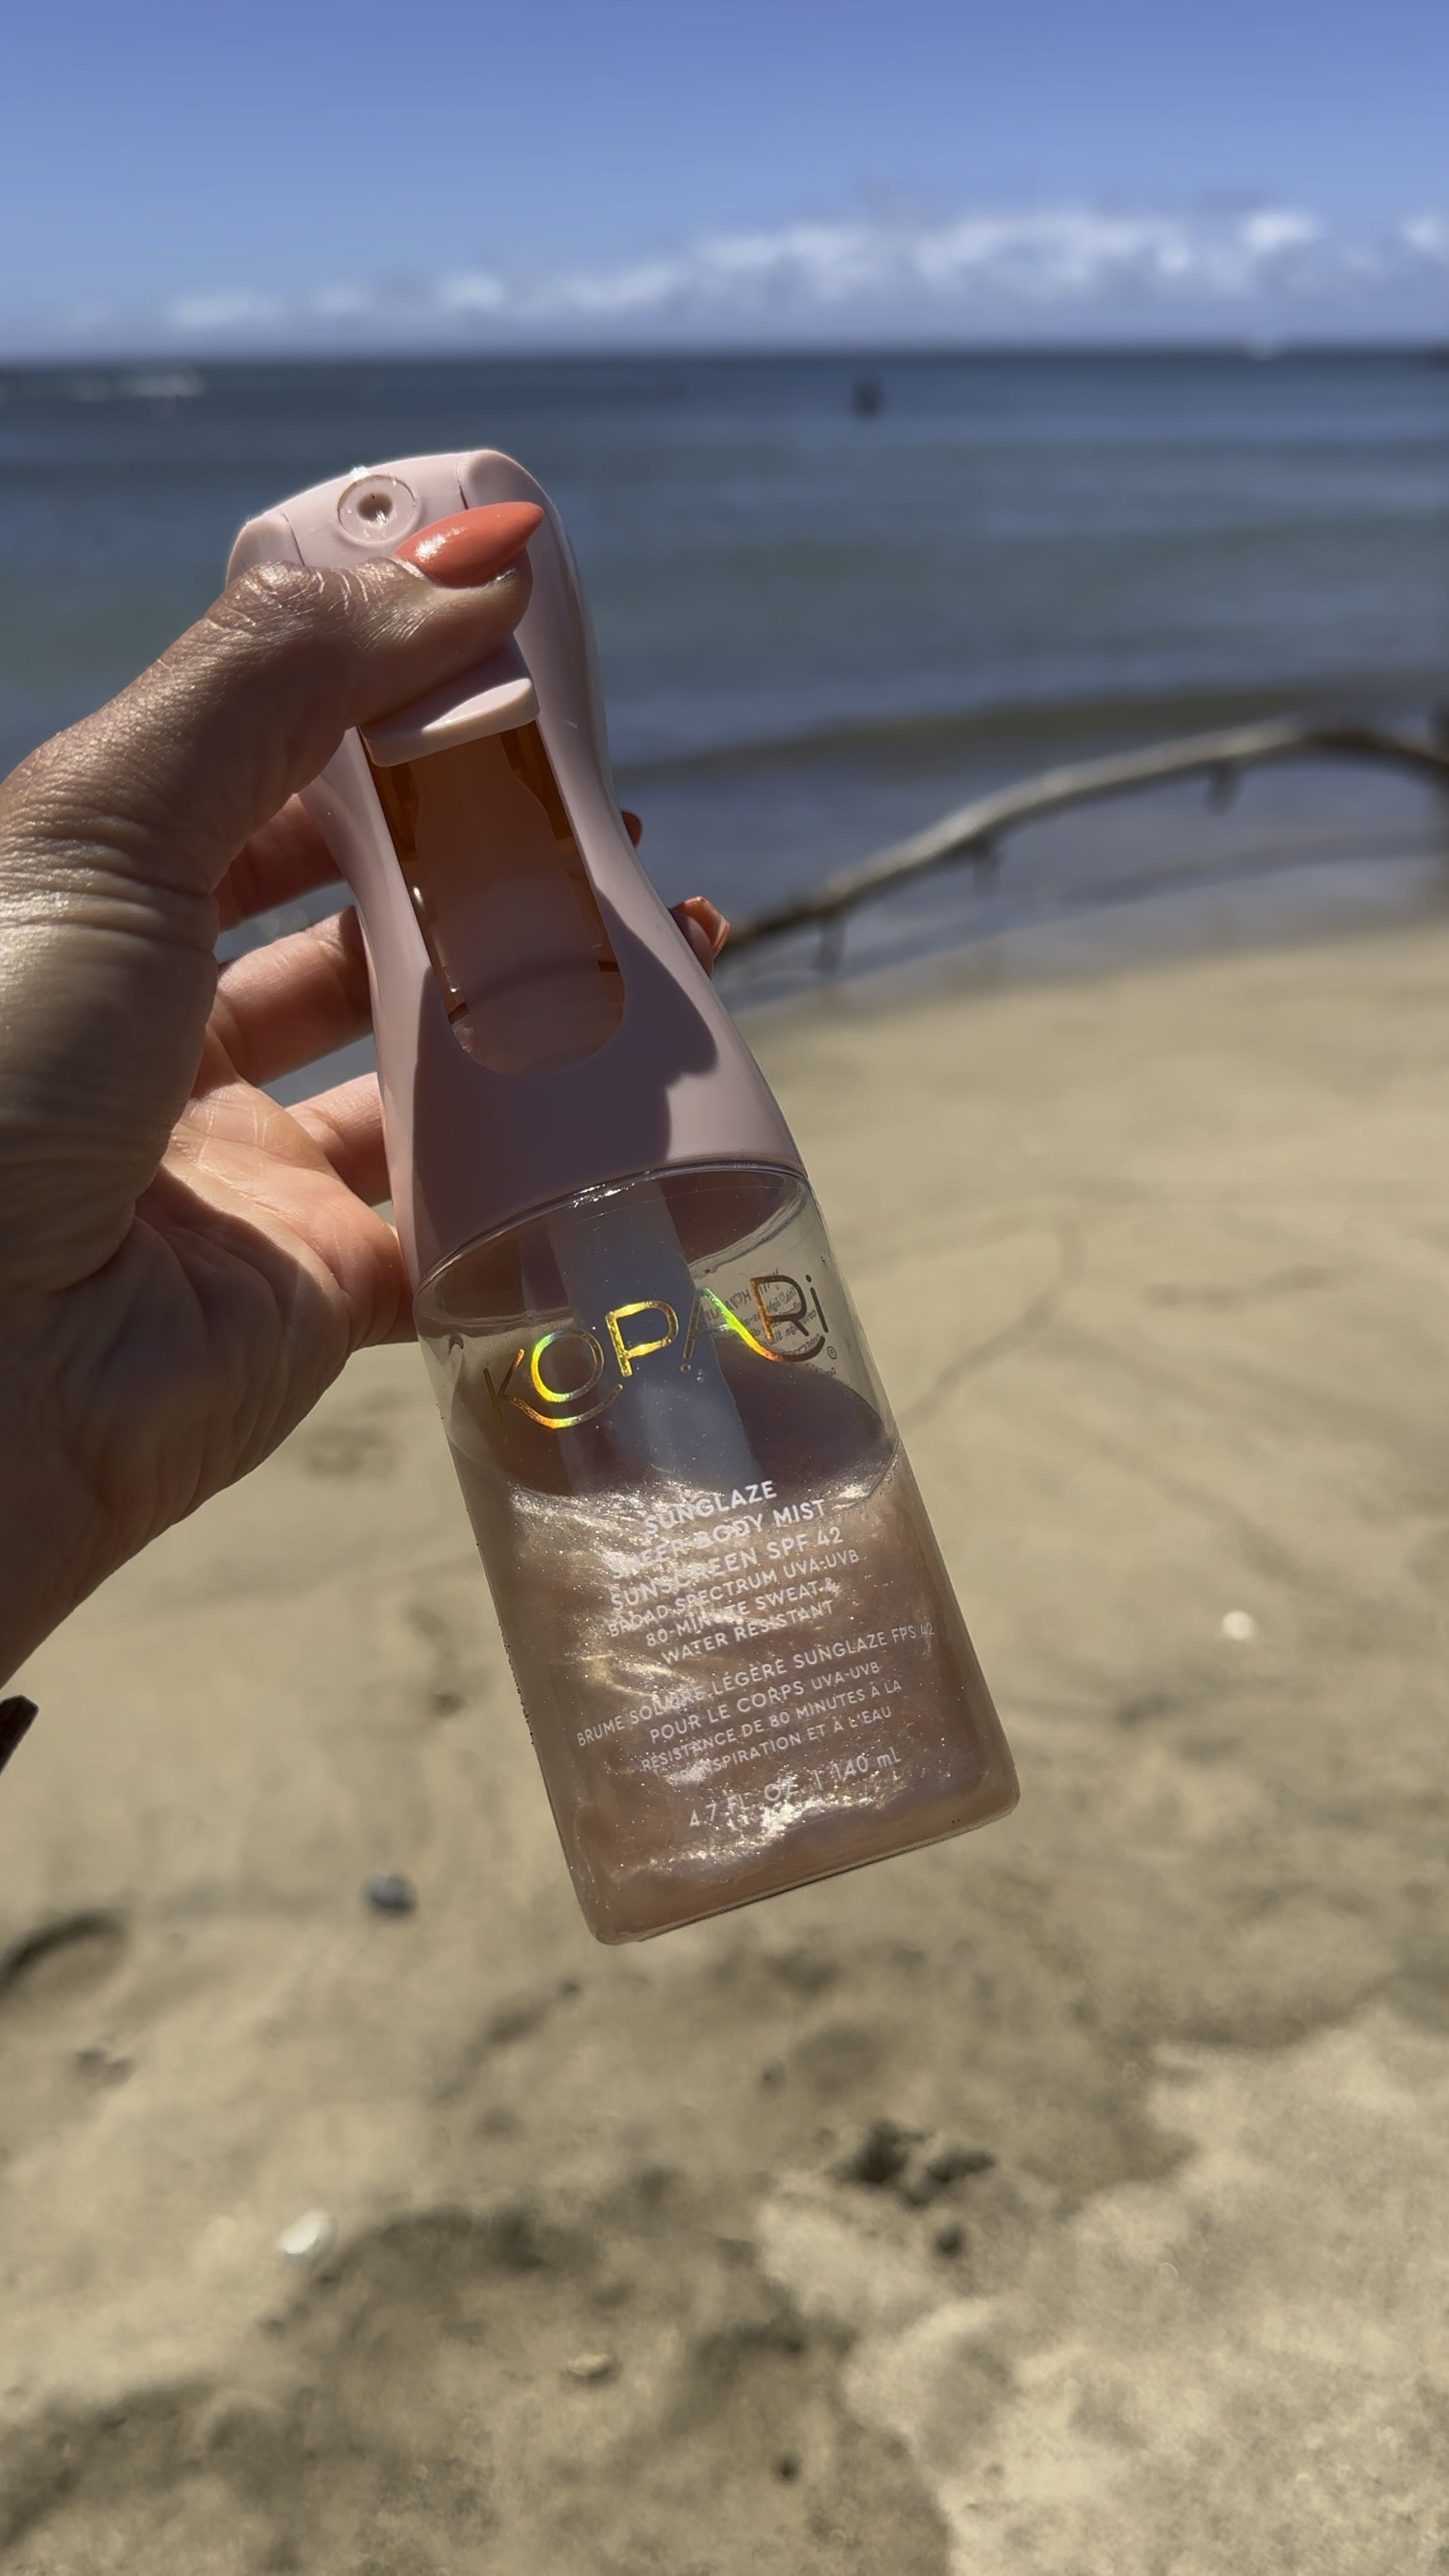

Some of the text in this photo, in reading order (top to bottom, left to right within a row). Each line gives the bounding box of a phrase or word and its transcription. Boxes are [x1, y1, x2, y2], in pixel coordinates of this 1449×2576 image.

[609, 1499, 825, 1579] SEER BODY MIST
[644, 1480, 777, 1534] SUNGLAZE
[607, 1549, 859, 1638] BROAD SPECTRUM UVA-UVB
[610, 1527, 843, 1611] SUNSCREEN SPF 42
[755, 1580, 818, 1609] SWEAT
[661, 1599, 834, 1665] WATER RESISTANT
[577, 1715, 625, 1746] BRUME
[793, 1631, 888, 1669] SUNGLAZE
[892, 1625, 916, 1644] FPS
[920, 1623, 934, 1636] 42
[650, 1662, 880, 1743] POUR LE CORPS UVA-UVB
[741, 1719, 765, 1737] DE
[769, 1711, 790, 1727] 80
[796, 1688, 865, 1719] MINUTES
[884, 1680, 902, 1695] LA
[666, 1732, 801, 1786] RNSPIRATION
[807, 1724, 826, 1740] ET
[849, 1706, 892, 1728] L'EAU
[876, 1746, 902, 1768] mL
